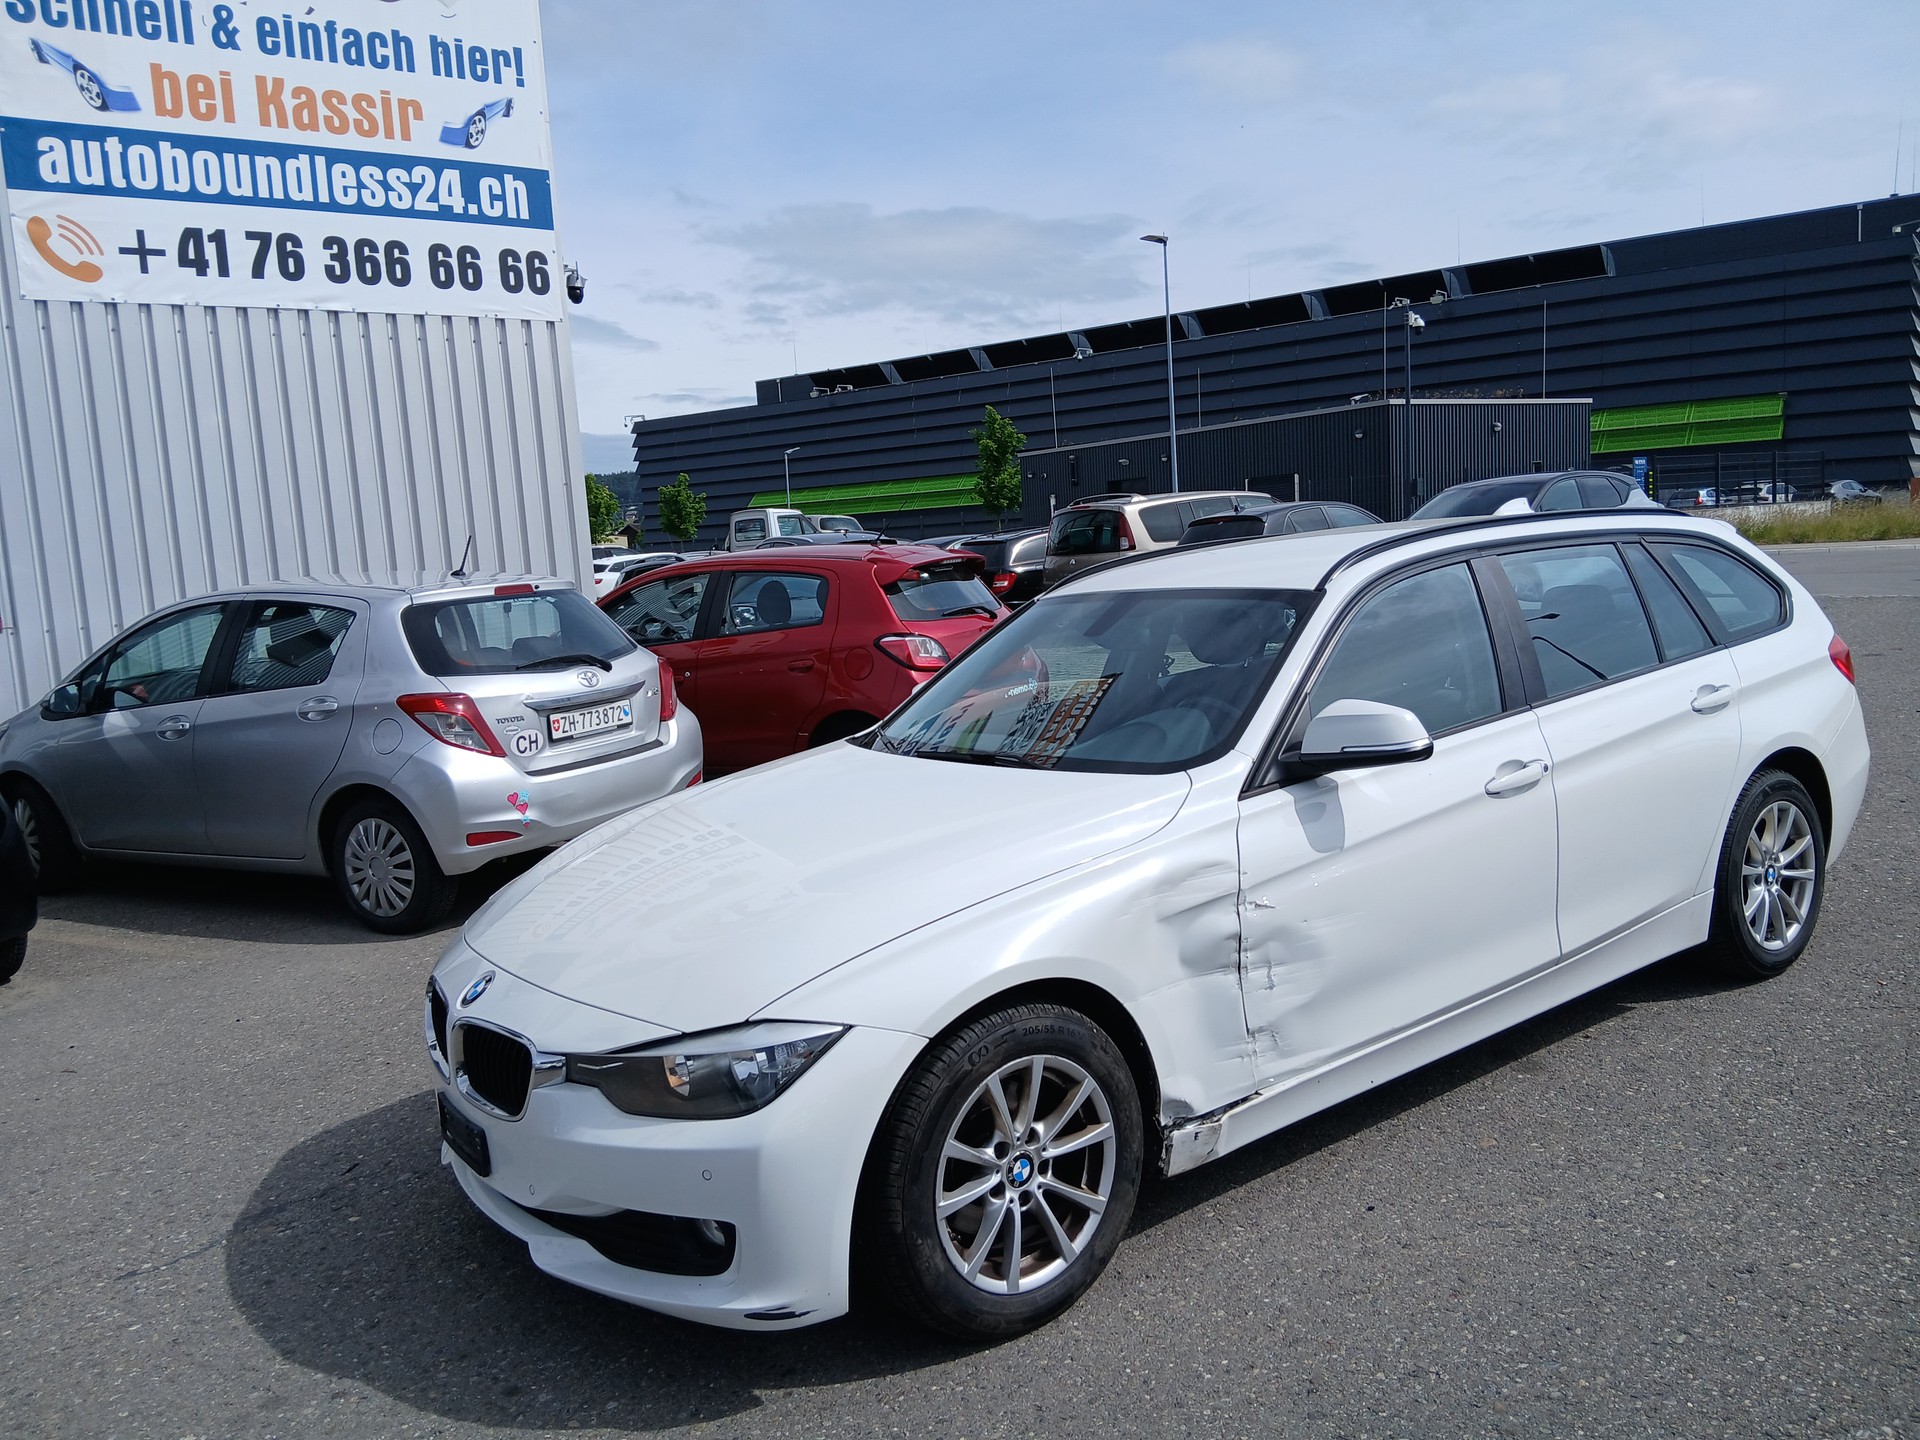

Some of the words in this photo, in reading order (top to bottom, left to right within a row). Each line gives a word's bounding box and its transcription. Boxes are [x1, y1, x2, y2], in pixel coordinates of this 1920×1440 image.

[211, 3, 242, 51] &
[255, 13, 416, 74] einfach
[429, 34, 525, 88] hier!
[149, 62, 236, 124] bei
[254, 74, 424, 142] Kassir
[37, 134, 531, 220] autoboundless24.ch
[244, 230, 306, 281] 76
[322, 235, 412, 287] 366
[428, 242, 483, 291] 66
[499, 247, 551, 296] 66
[495, 715, 525, 725] TOYOTA
[515, 732, 540, 754] CH
[1022, 1025, 1055, 1037] 205/55
[1058, 1026, 1065, 1035] R
